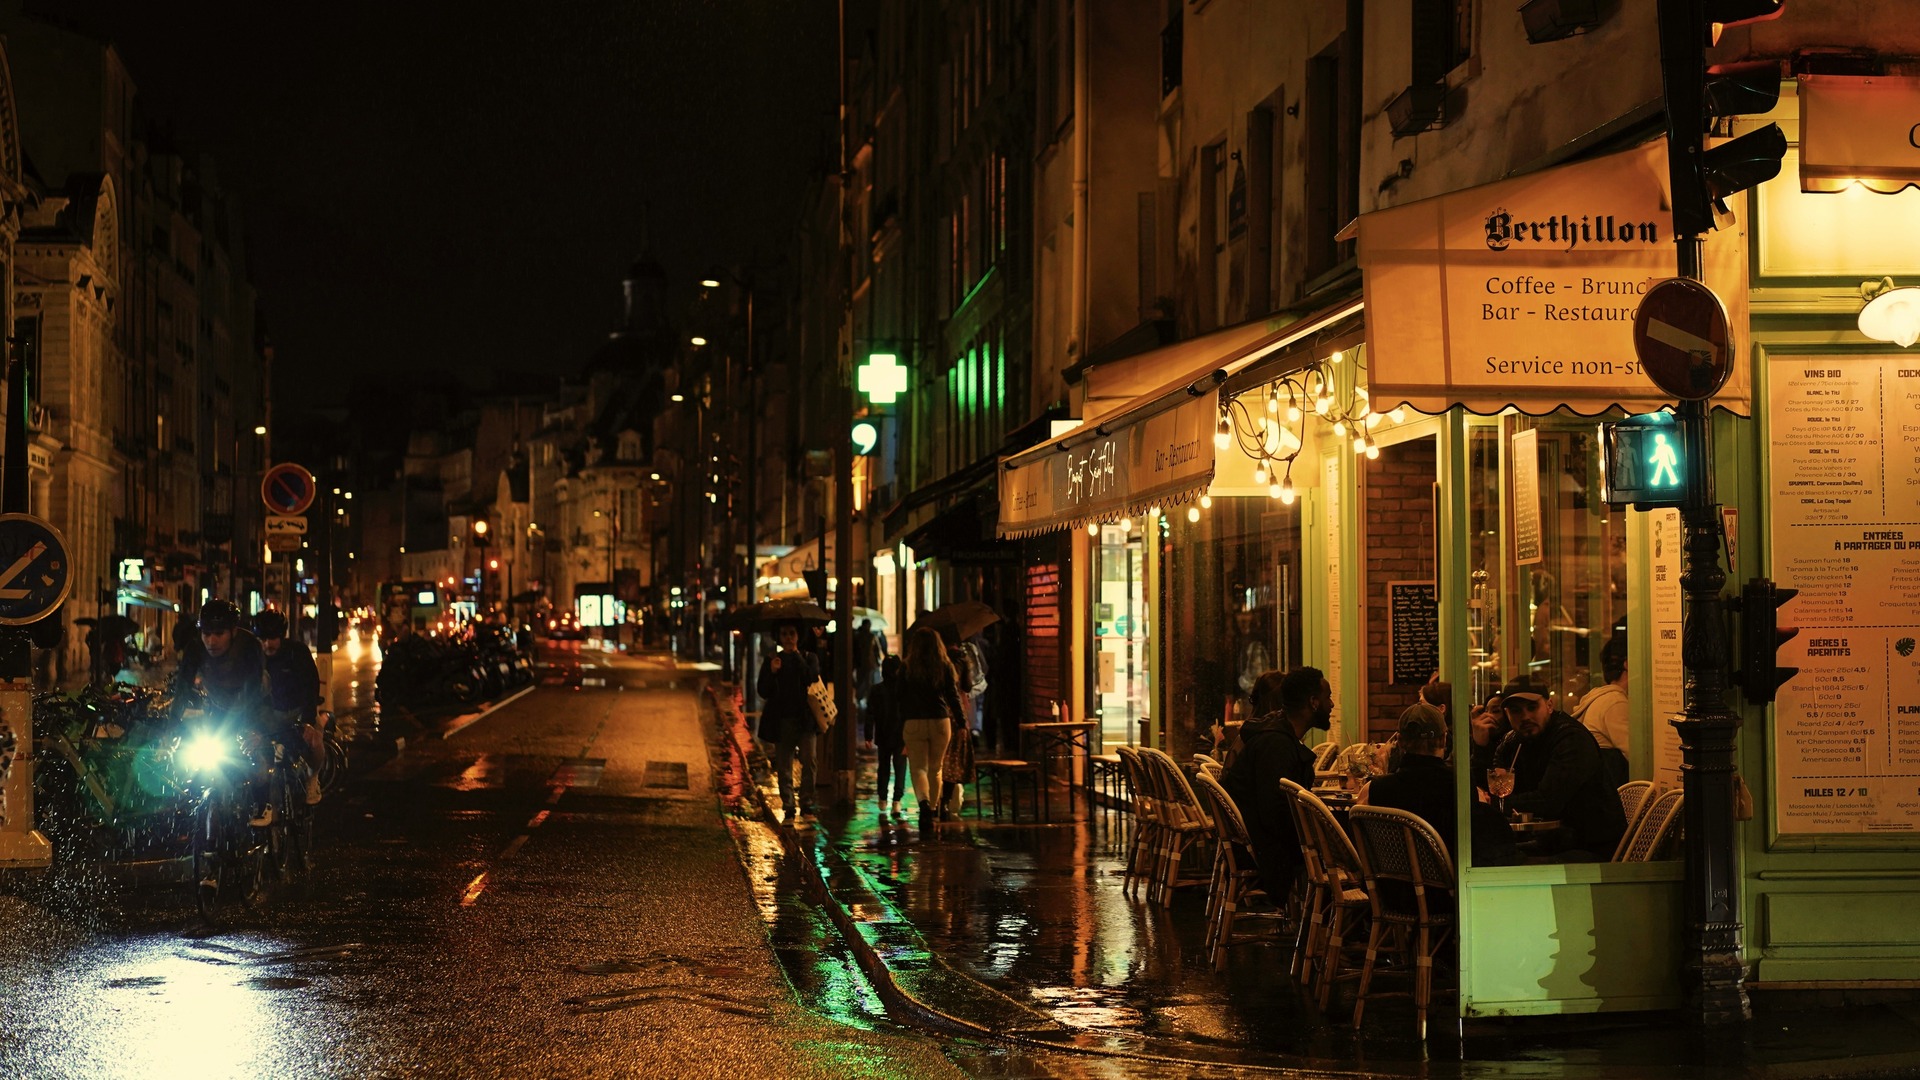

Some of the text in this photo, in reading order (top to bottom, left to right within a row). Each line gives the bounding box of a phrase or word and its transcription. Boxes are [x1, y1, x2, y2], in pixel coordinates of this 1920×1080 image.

[1485, 207, 1658, 253] Berthillon
[1486, 276, 1556, 295] Coffee
[1582, 277, 1652, 295] Brunc
[1482, 303, 1520, 320] Bar
[1486, 356, 1564, 374] Service
[1804, 370, 1842, 378] VINS BIO
[1863, 530, 1903, 540] ENTRÉES
[1844, 542, 1891, 550] PARTAGER
[1894, 542, 1906, 550] OU
[1807, 648, 1850, 656] APERITIFS
[1804, 788, 1868, 797] MULES 12 10
